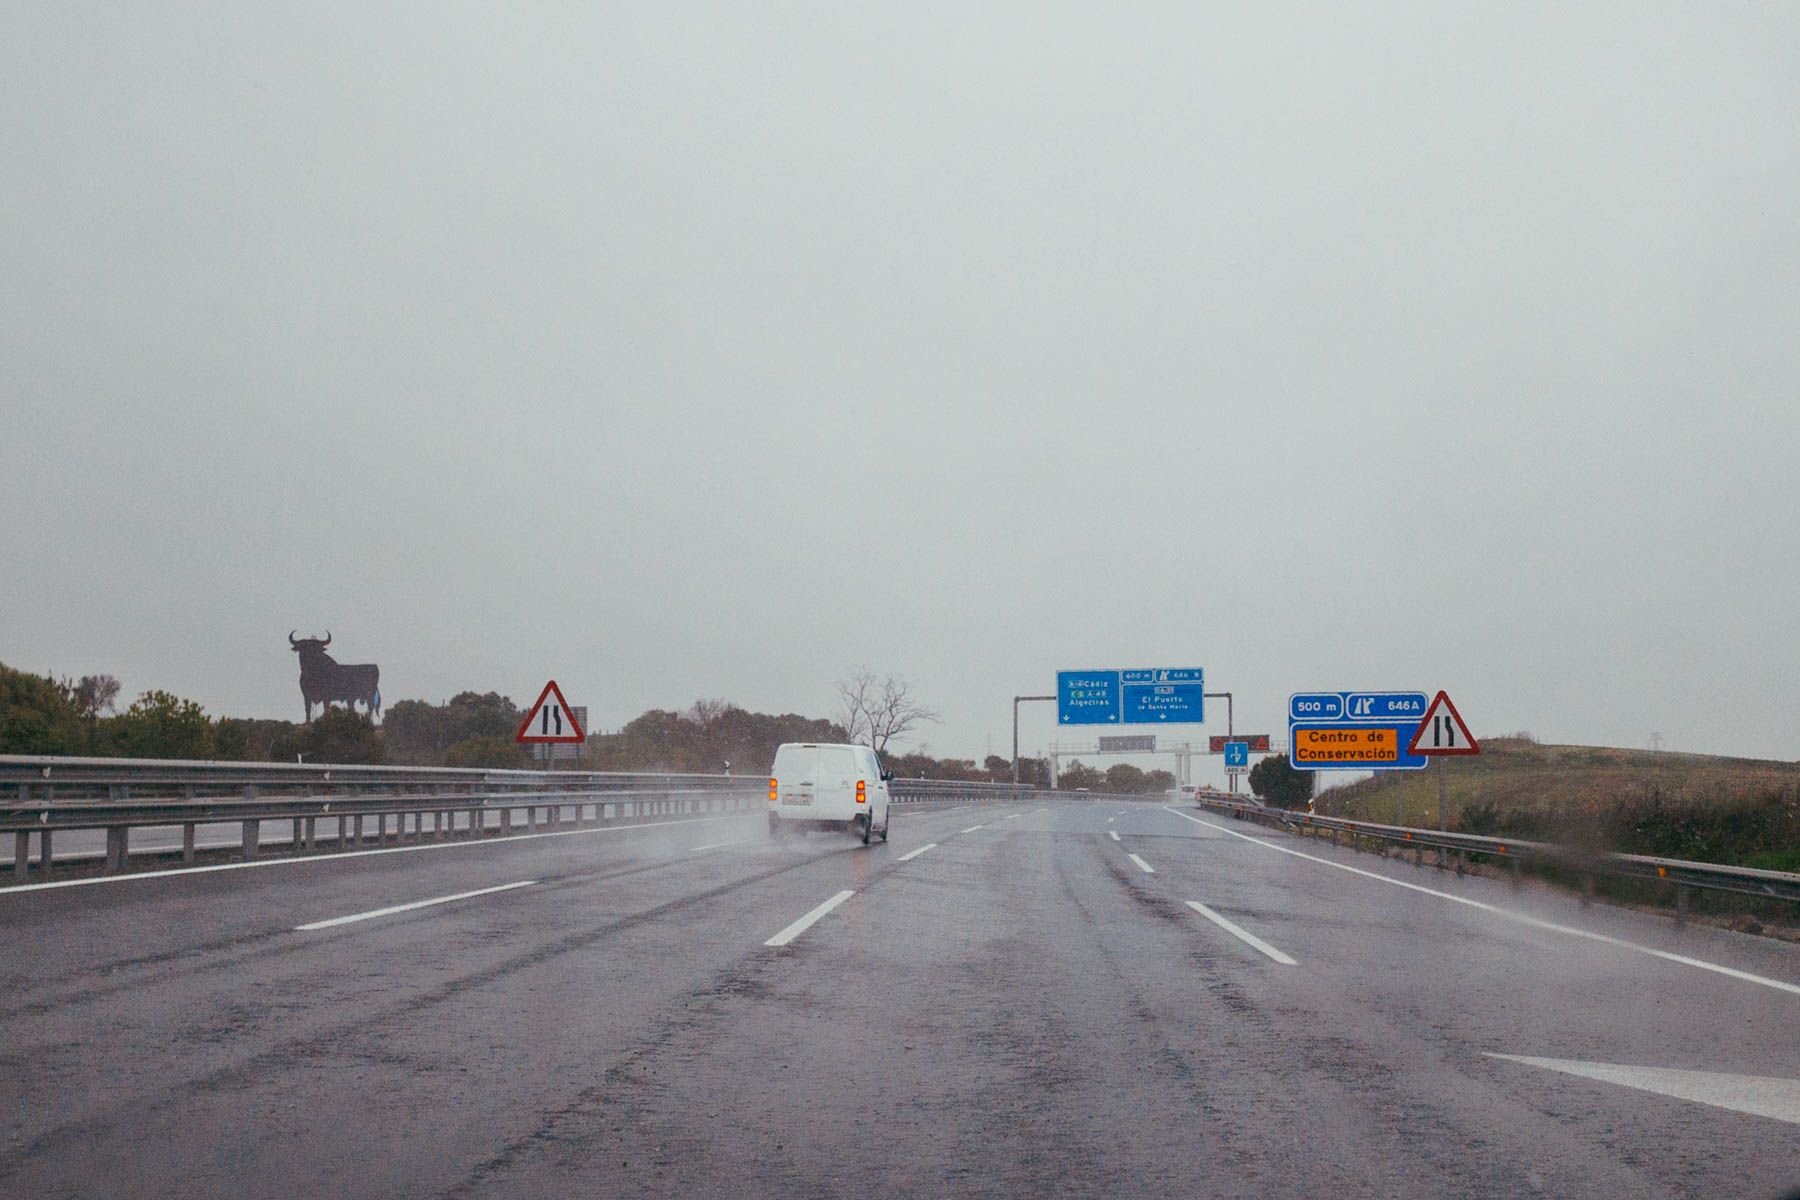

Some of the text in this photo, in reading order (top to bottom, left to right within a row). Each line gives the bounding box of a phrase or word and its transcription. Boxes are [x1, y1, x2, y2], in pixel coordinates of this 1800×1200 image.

[1298, 702, 1336, 712] 500 m
[1309, 732, 1384, 742] Centro de
[1298, 748, 1395, 759] Conservación
